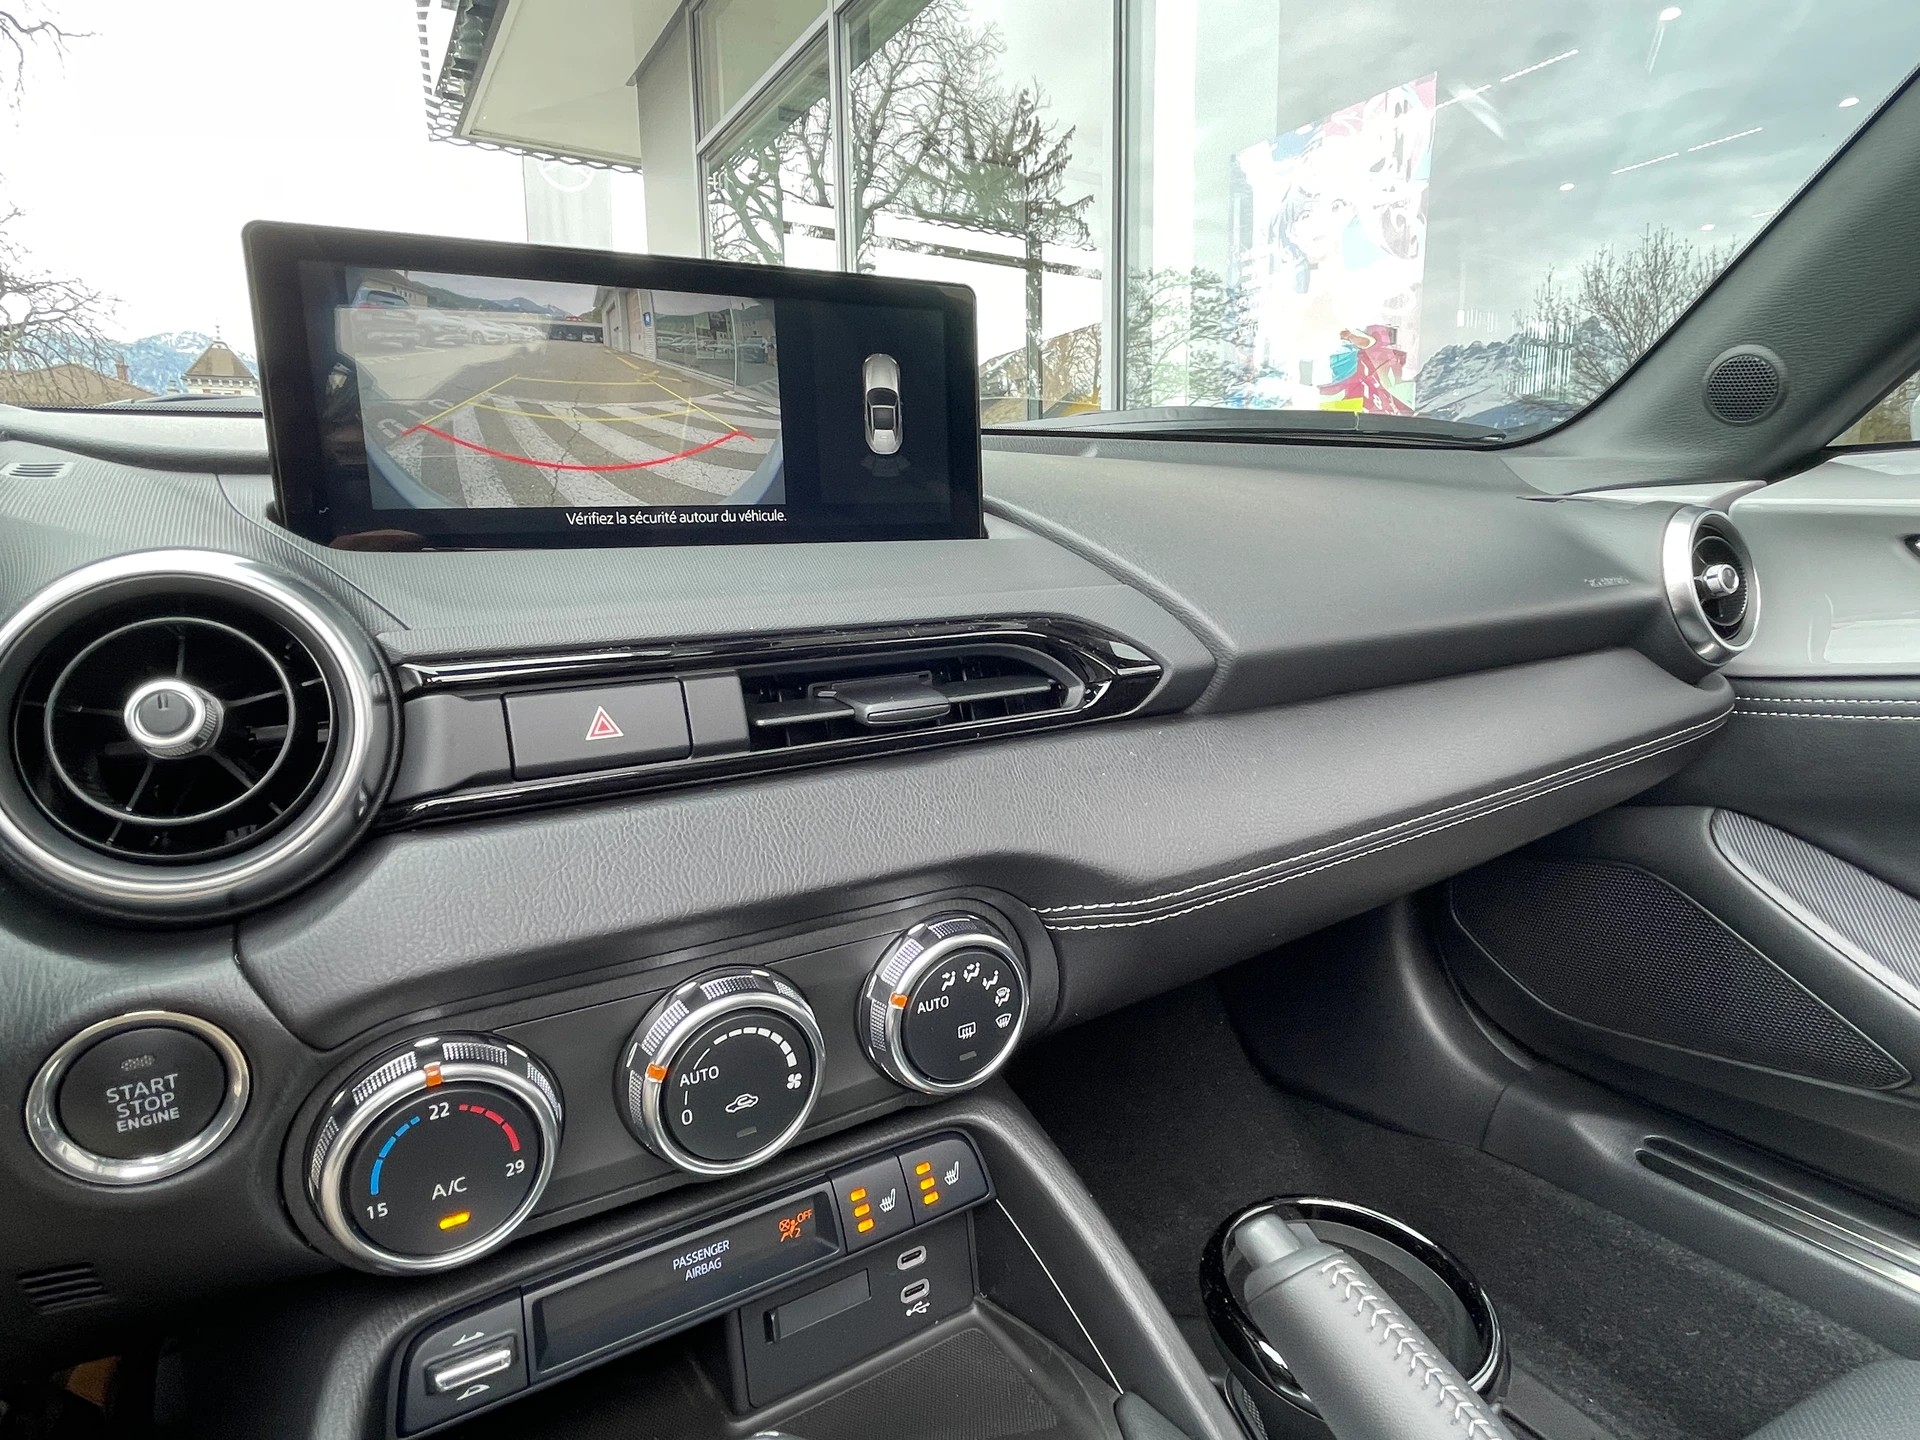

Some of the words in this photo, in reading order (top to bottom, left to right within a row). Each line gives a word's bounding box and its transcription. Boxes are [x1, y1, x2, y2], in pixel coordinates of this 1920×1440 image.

[565, 511, 614, 525] Vérifiez
[615, 511, 628, 525] la
[629, 510, 677, 525] sécurité
[679, 511, 719, 523] autour
[721, 510, 737, 523] du
[737, 509, 787, 522] véhicule.
[917, 995, 950, 1015] AUTO
[679, 1065, 720, 1088] AUTO
[106, 1073, 178, 1104] START
[116, 1092, 175, 1119] STOP
[428, 1102, 451, 1121] 22
[116, 1107, 180, 1133] ENGINE
[505, 1159, 526, 1178] 29
[431, 1176, 468, 1201] A/C
[366, 1202, 389, 1220] 15
[796, 1208, 813, 1223] OFF
[672, 1239, 731, 1271] PASSENGER
[685, 1257, 723, 1282] AIRBAG
